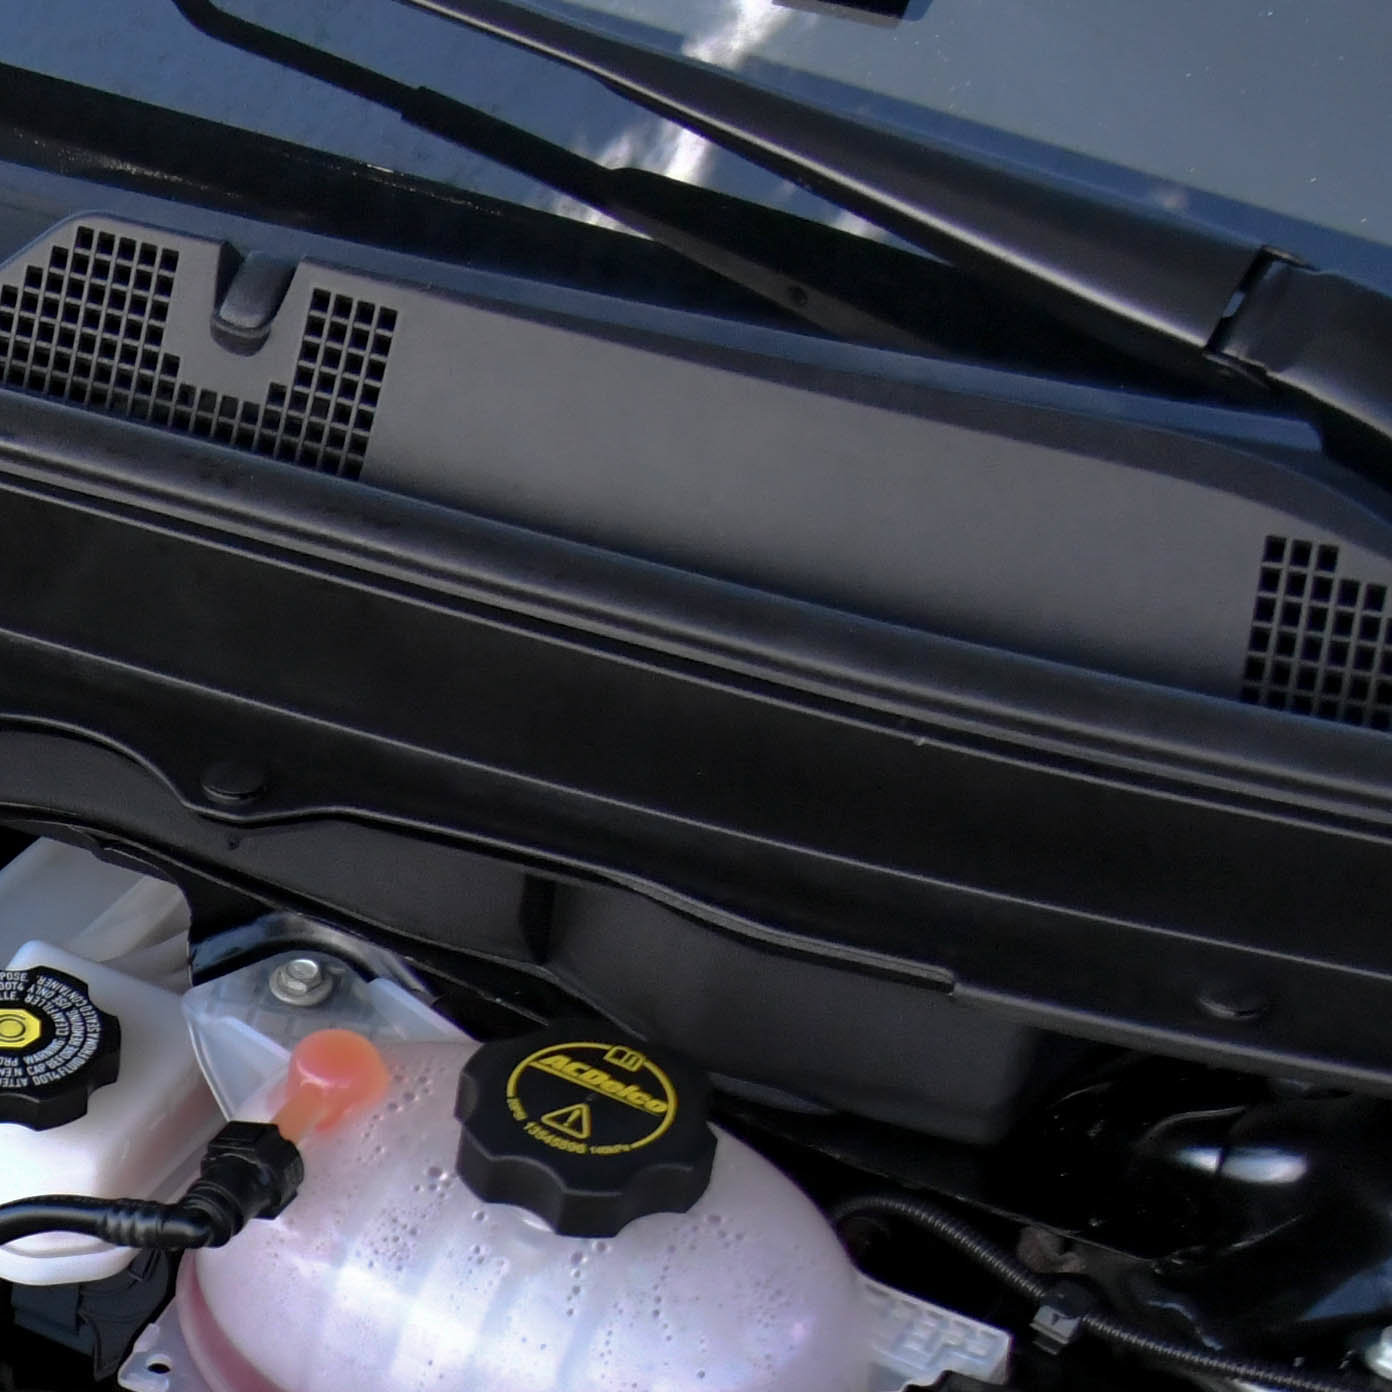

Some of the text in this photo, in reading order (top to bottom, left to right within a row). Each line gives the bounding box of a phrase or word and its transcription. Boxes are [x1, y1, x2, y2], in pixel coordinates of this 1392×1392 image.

[26, 983, 56, 999] ONLY
[24, 994, 58, 1015] FILLER
[52, 994, 73, 1010] USE
[79, 1005, 101, 1032] SEALED
[86, 1032, 100, 1040] A
[45, 1044, 79, 1069] BEFORE
[77, 1038, 98, 1060] FROM
[26, 1063, 46, 1076] CAP
[56, 1055, 86, 1077] FLUID
[536, 1054, 669, 1114] ACDelco
